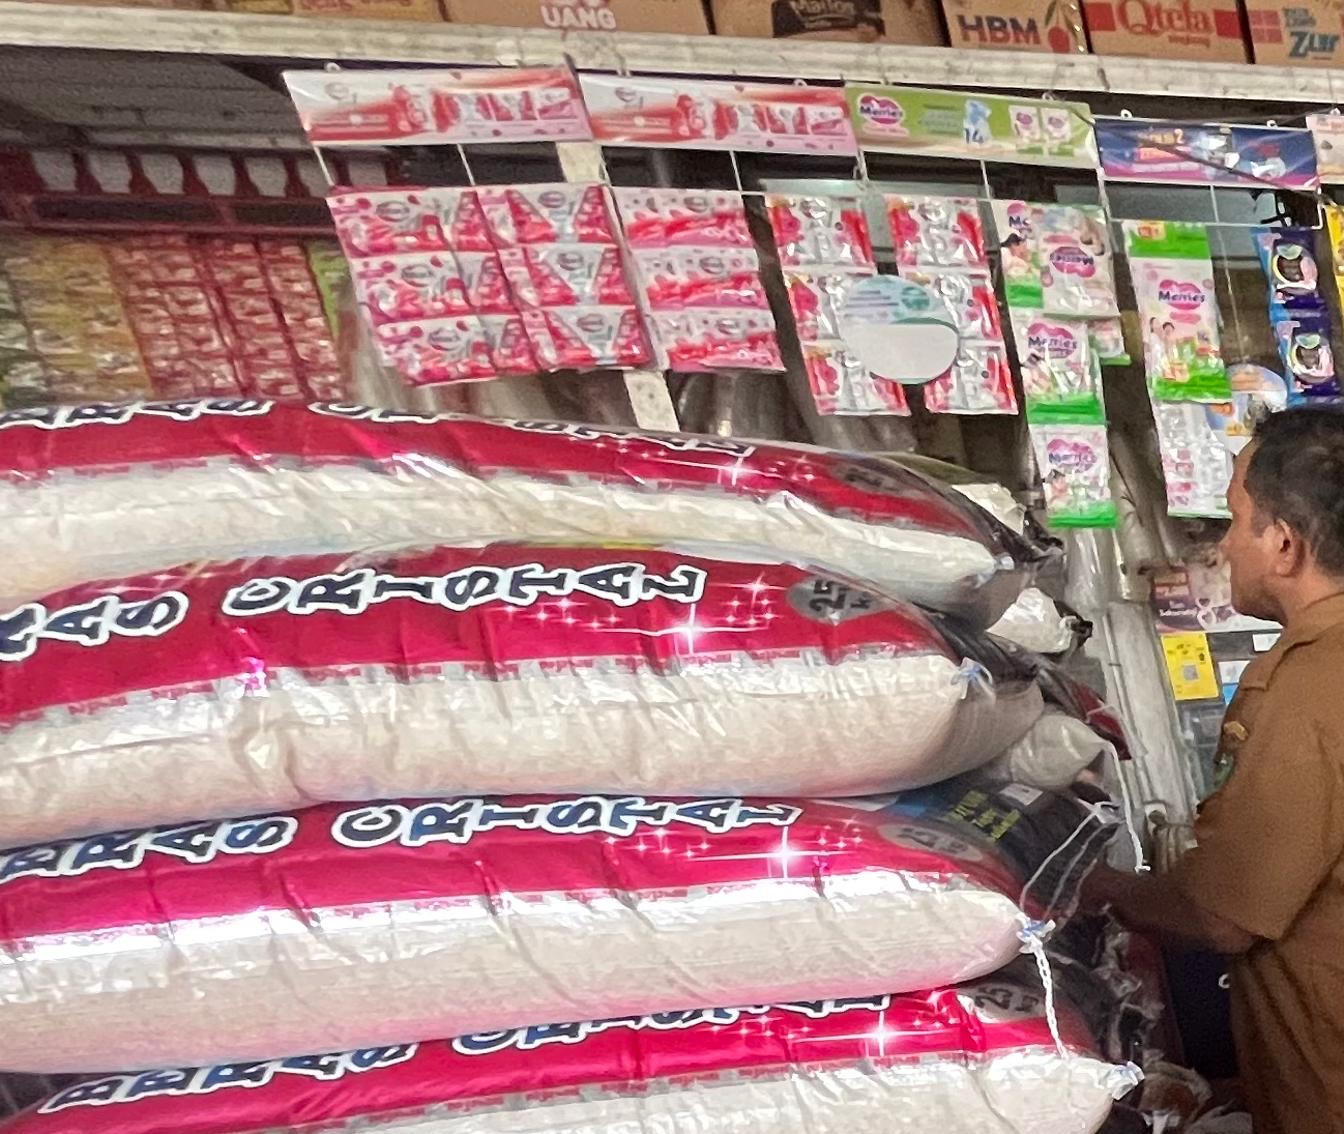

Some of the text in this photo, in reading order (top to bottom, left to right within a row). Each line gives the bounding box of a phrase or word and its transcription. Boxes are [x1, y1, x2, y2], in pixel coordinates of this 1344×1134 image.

[541, 5, 617, 31] UANG
[957, 14, 1041, 45] HBM
[965, 128, 984, 145] 14
[222, 562, 708, 616] CRISTAL
[332, 796, 803, 851] CRISTAL
